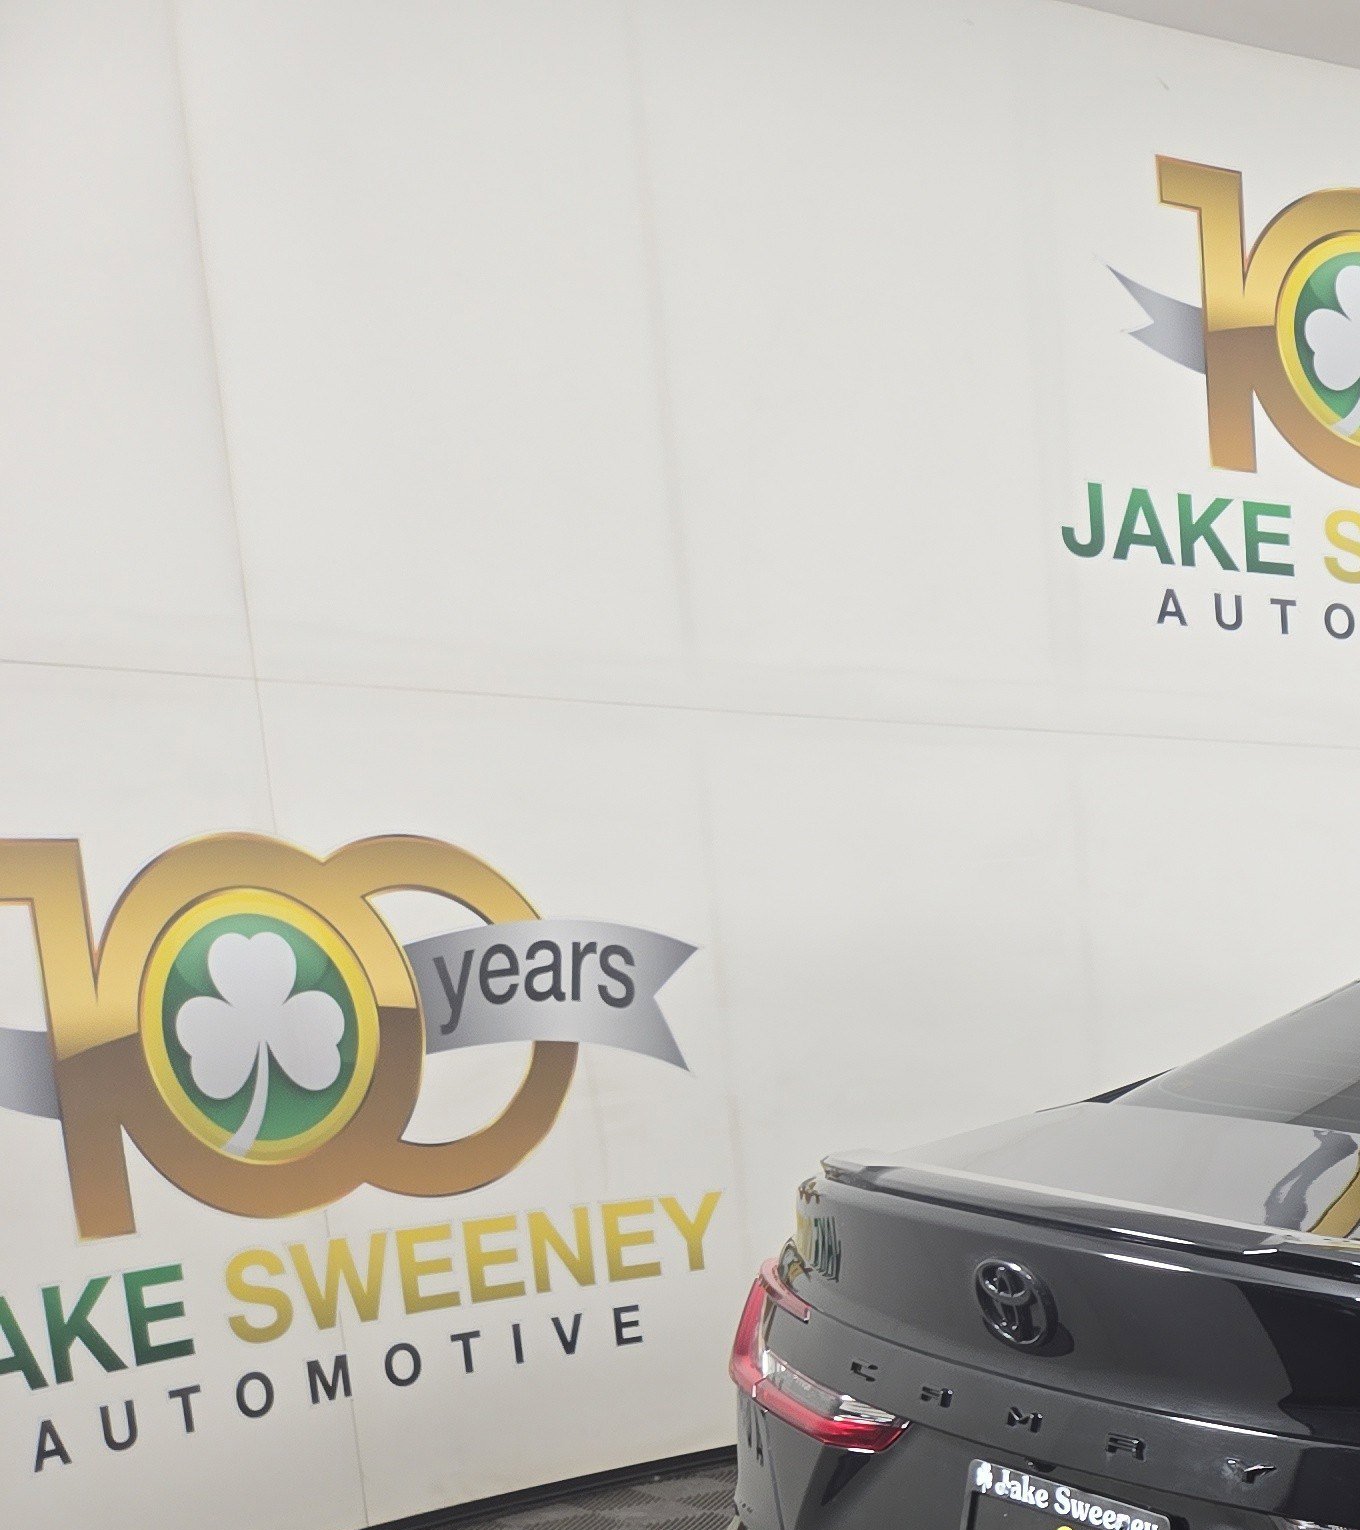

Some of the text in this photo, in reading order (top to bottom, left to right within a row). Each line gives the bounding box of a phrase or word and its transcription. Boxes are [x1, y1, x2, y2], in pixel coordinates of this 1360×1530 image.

[1061, 481, 1296, 577] JAKE
[432, 938, 636, 1036] years
[0, 1263, 196, 1391] AKE
[224, 1189, 723, 1345] SWEENEY
[33, 1304, 644, 1473] AUTOMOTIVE
[995, 1469, 1049, 1509] Jake
